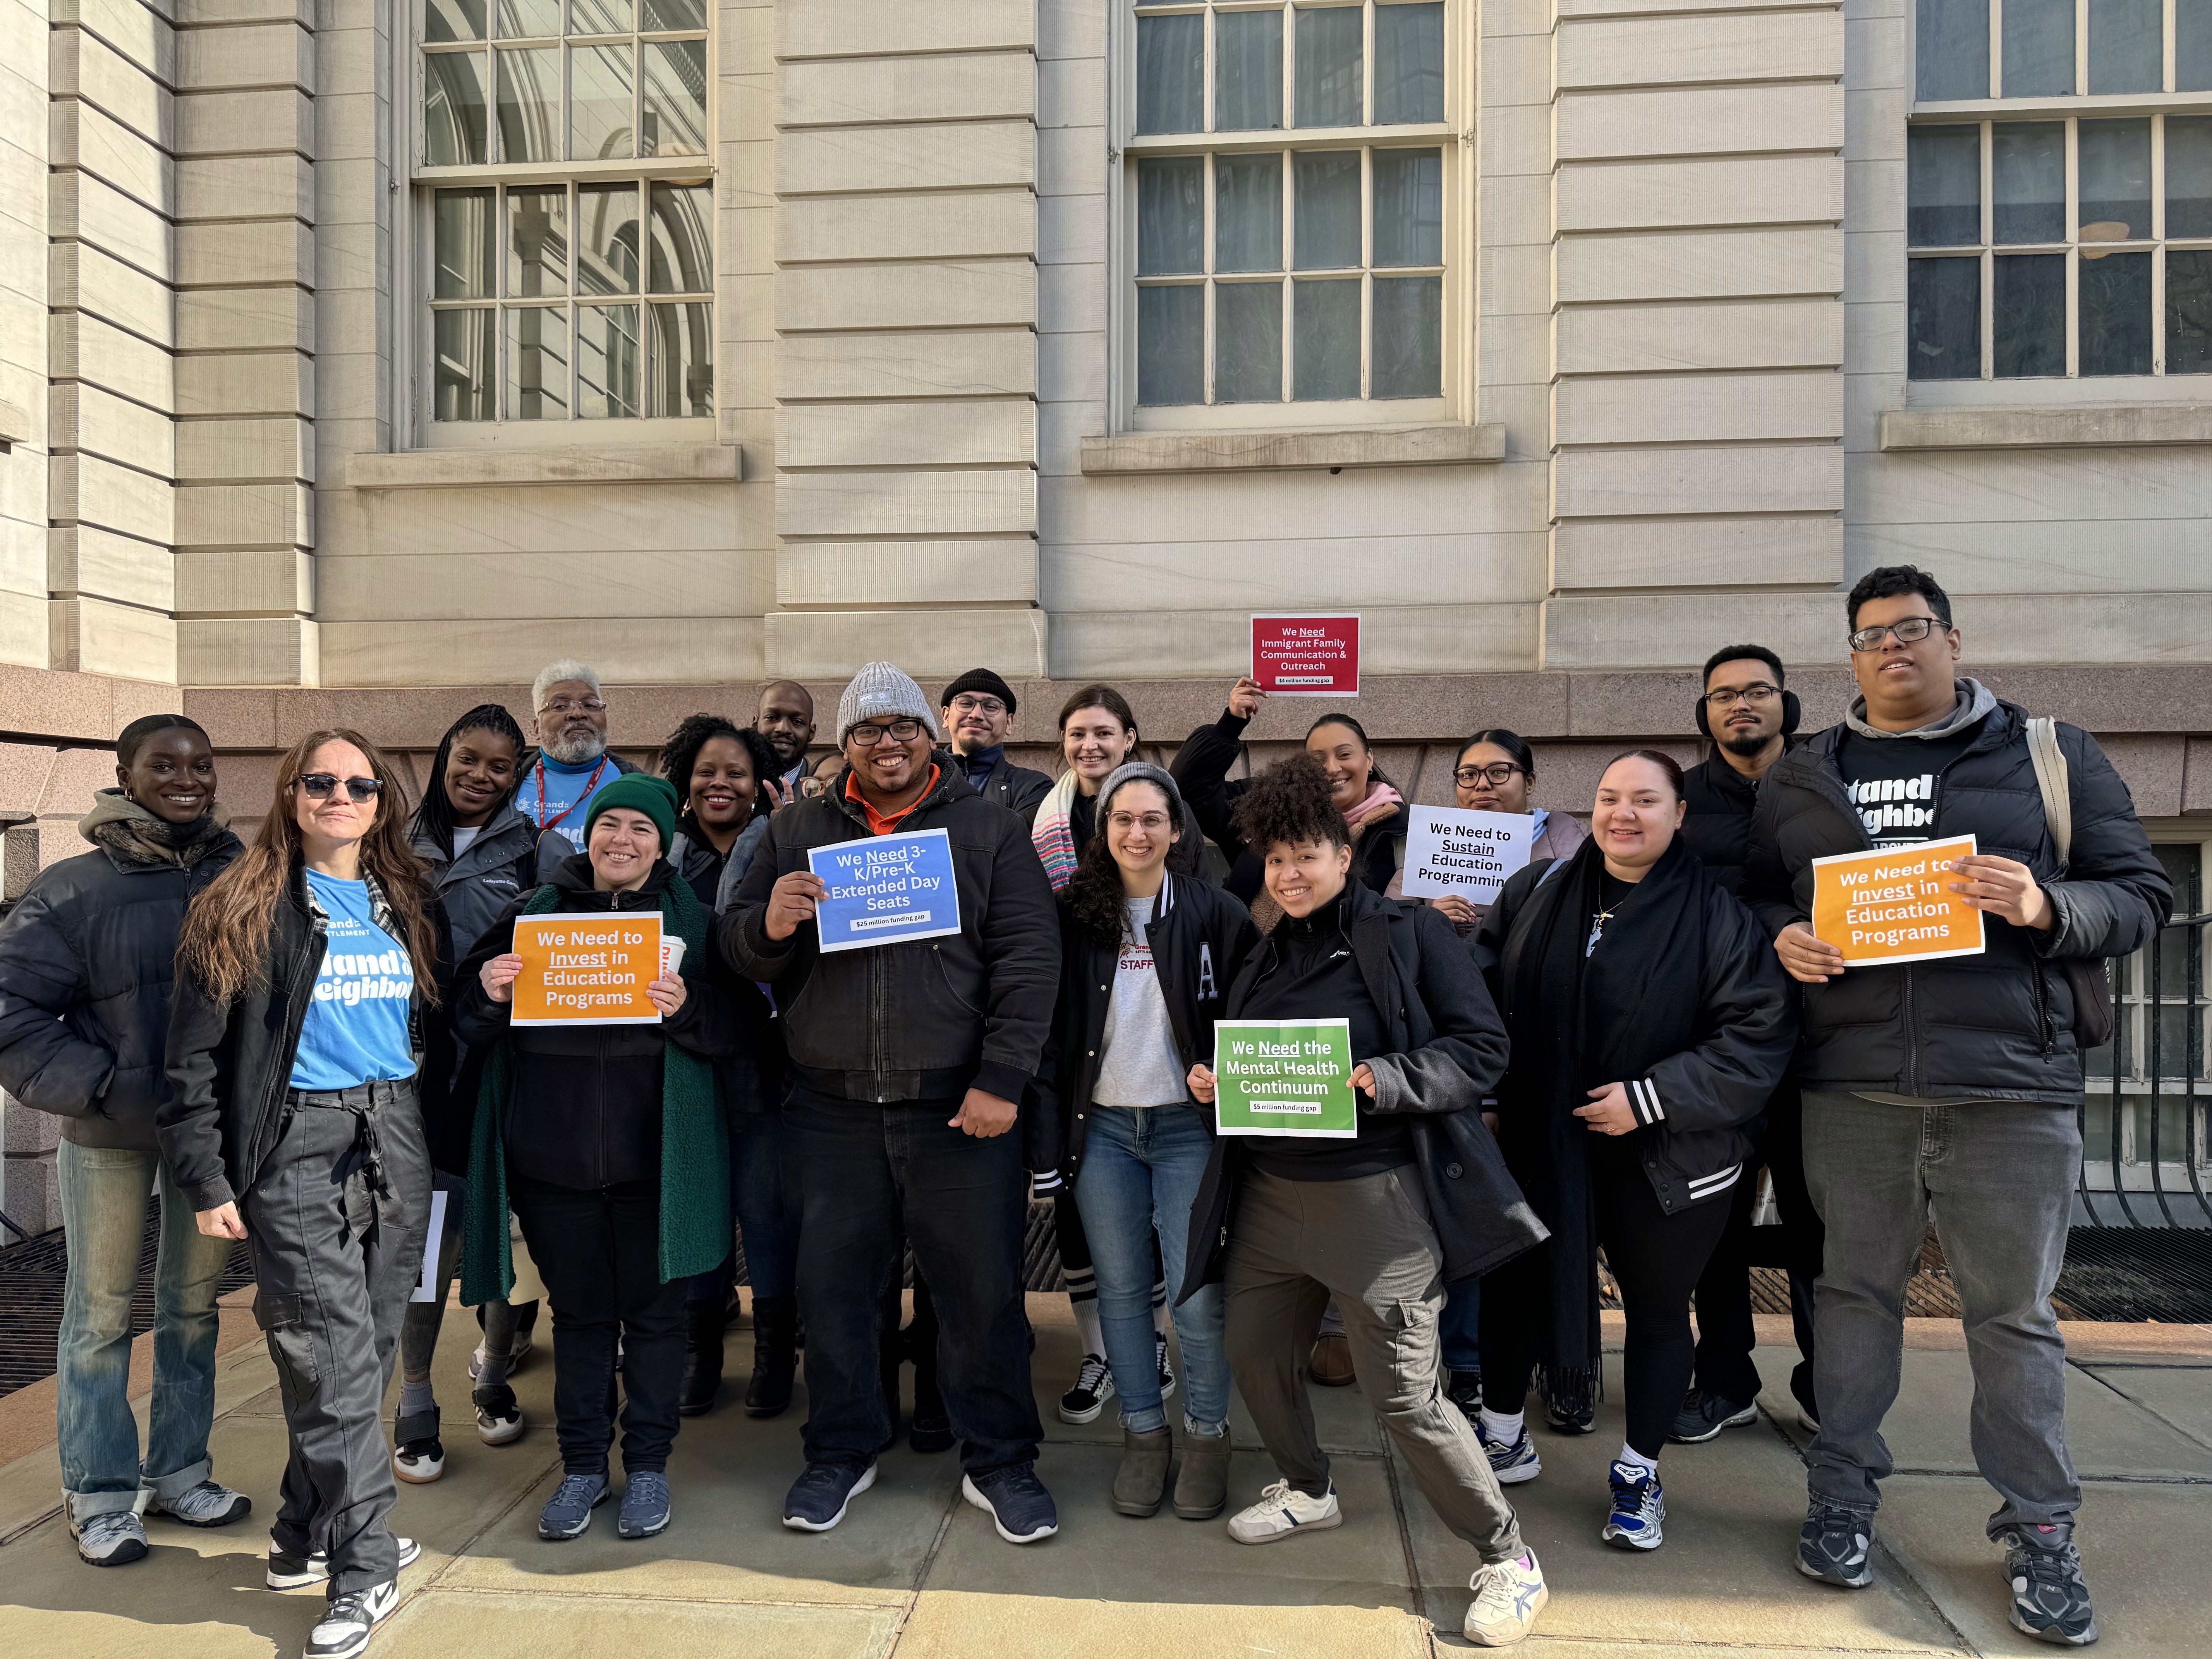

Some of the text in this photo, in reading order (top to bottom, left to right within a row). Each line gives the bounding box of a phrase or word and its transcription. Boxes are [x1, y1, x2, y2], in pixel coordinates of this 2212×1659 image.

[1300, 627, 1324, 636] Need
[1262, 639, 1346, 649] Immigrant Family
[1261, 651, 1337, 659] Communication
[1281, 662, 1325, 670] Outreach
[1845, 775, 1933, 804] tand
[1431, 823, 1511, 841] We Need to
[1443, 840, 1494, 855] Sustain
[836, 845, 926, 867] We Need 3-
[1432, 854, 1502, 871] Education
[855, 862, 916, 881] K/Pre-K
[1419, 868, 1504, 887] Programmin
[1840, 860, 1952, 886] We Need to
[832, 877, 940, 899] Extended Day
[1853, 880, 1939, 902] Invest in
[867, 896, 910, 910] Seats
[1846, 902, 1949, 924] Education
[329, 917, 354, 929] and
[538, 930, 642, 946] We Need to
[1851, 925, 1949, 946] Programs
[321, 949, 400, 976] tand
[550, 950, 628, 965] Invest in
[1120, 960, 1154, 970] STAFF
[544, 970, 635, 986] Education
[1198, 942, 1218, 1001] A
[546, 991, 632, 1008] Programs
[1232, 1041, 1331, 1055] We Need the
[1226, 1061, 1339, 1075] Mental Health
[1240, 1080, 1328, 1094] Continuum
